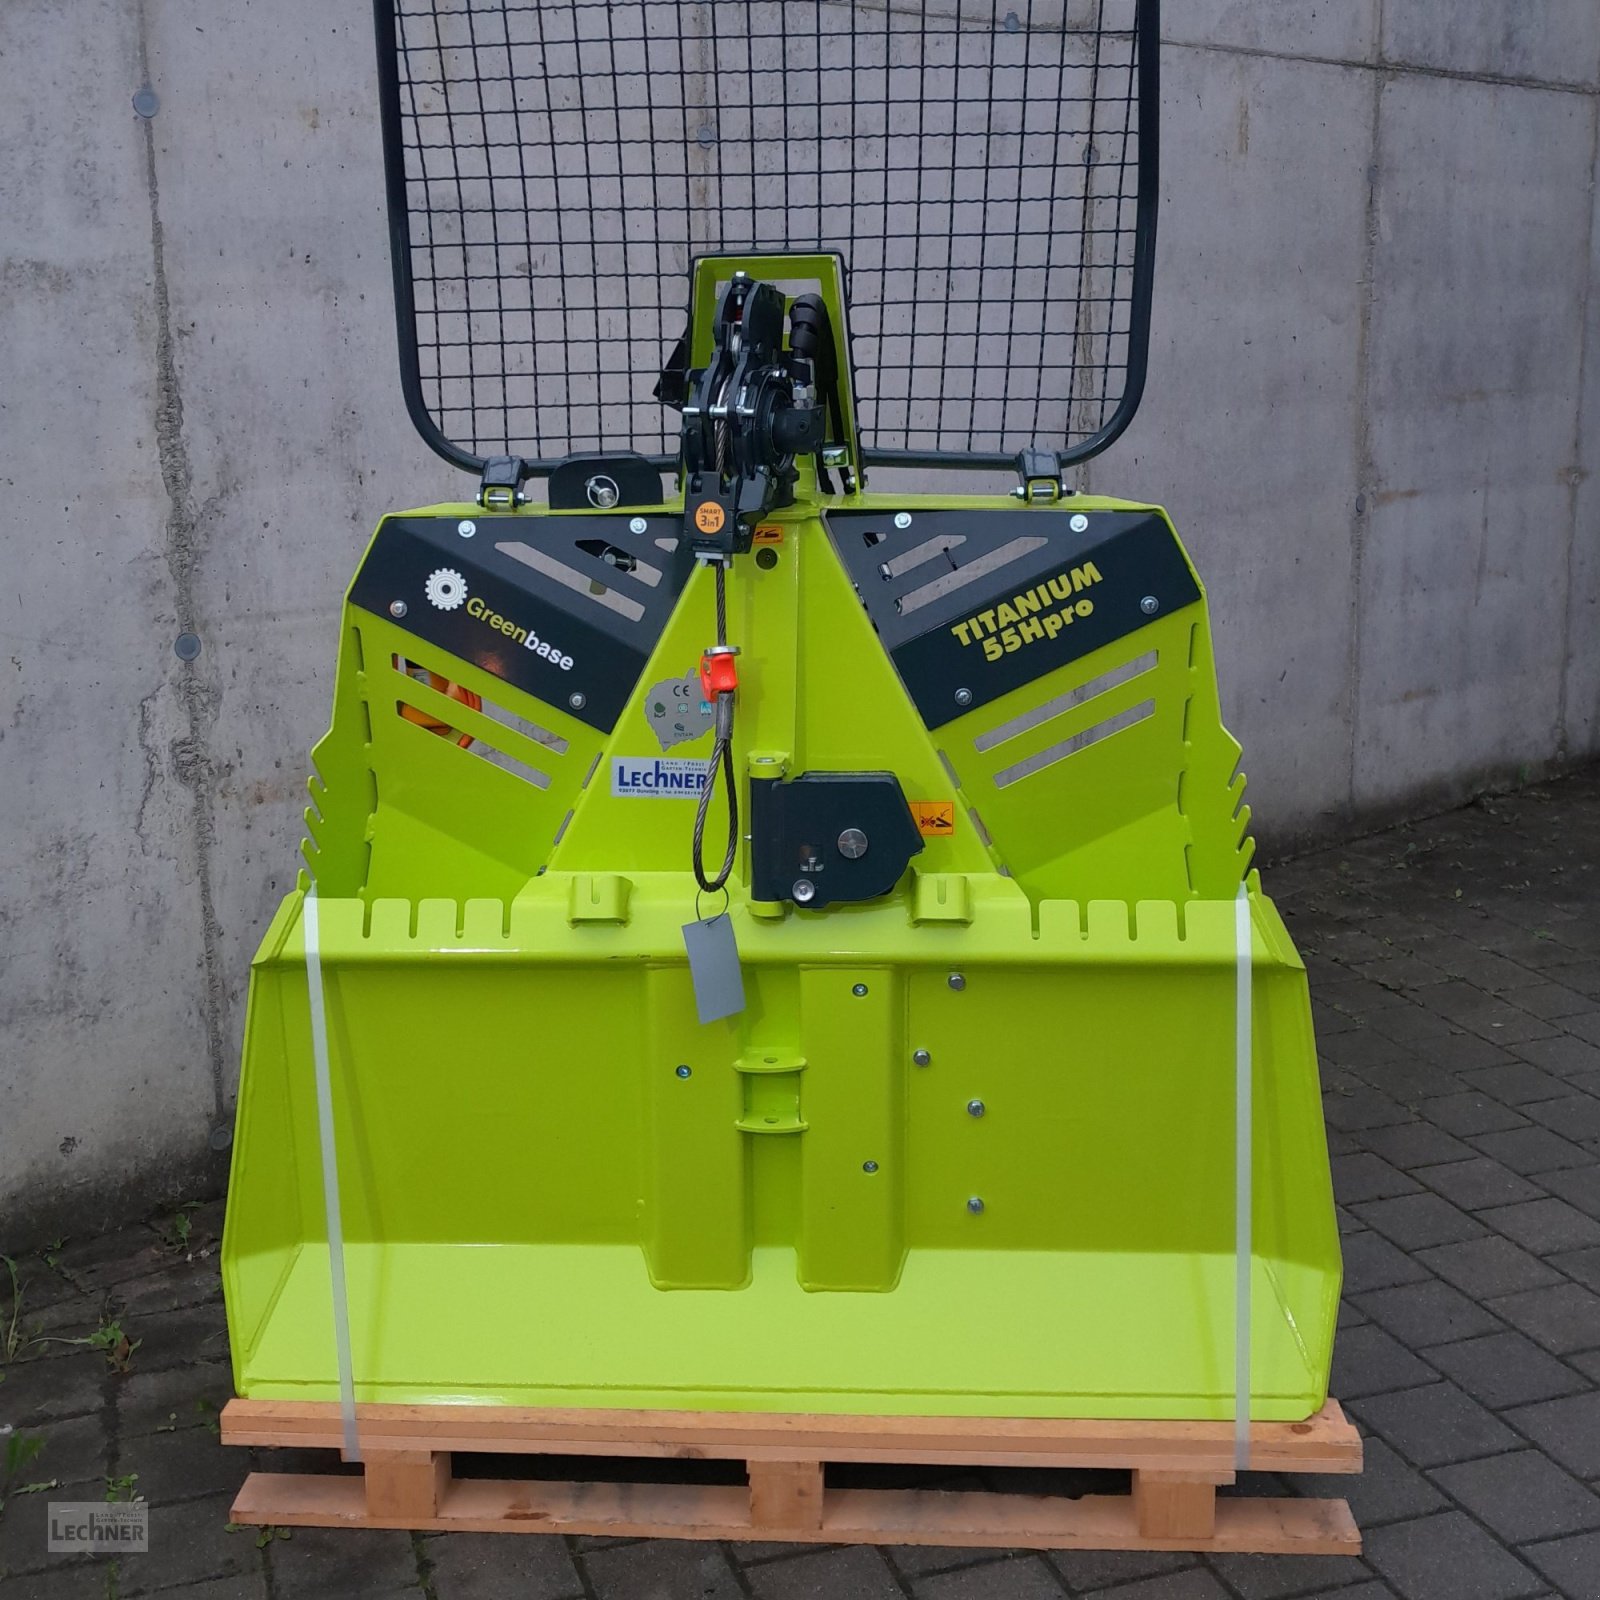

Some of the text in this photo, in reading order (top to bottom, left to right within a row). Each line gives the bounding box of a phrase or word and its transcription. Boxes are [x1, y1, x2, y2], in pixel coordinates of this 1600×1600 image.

[700, 515, 720, 527] 3in1
[466, 597, 575, 671] Greenbase
[951, 561, 1103, 647] TITANIUM
[982, 599, 1094, 662] 55Hpro
